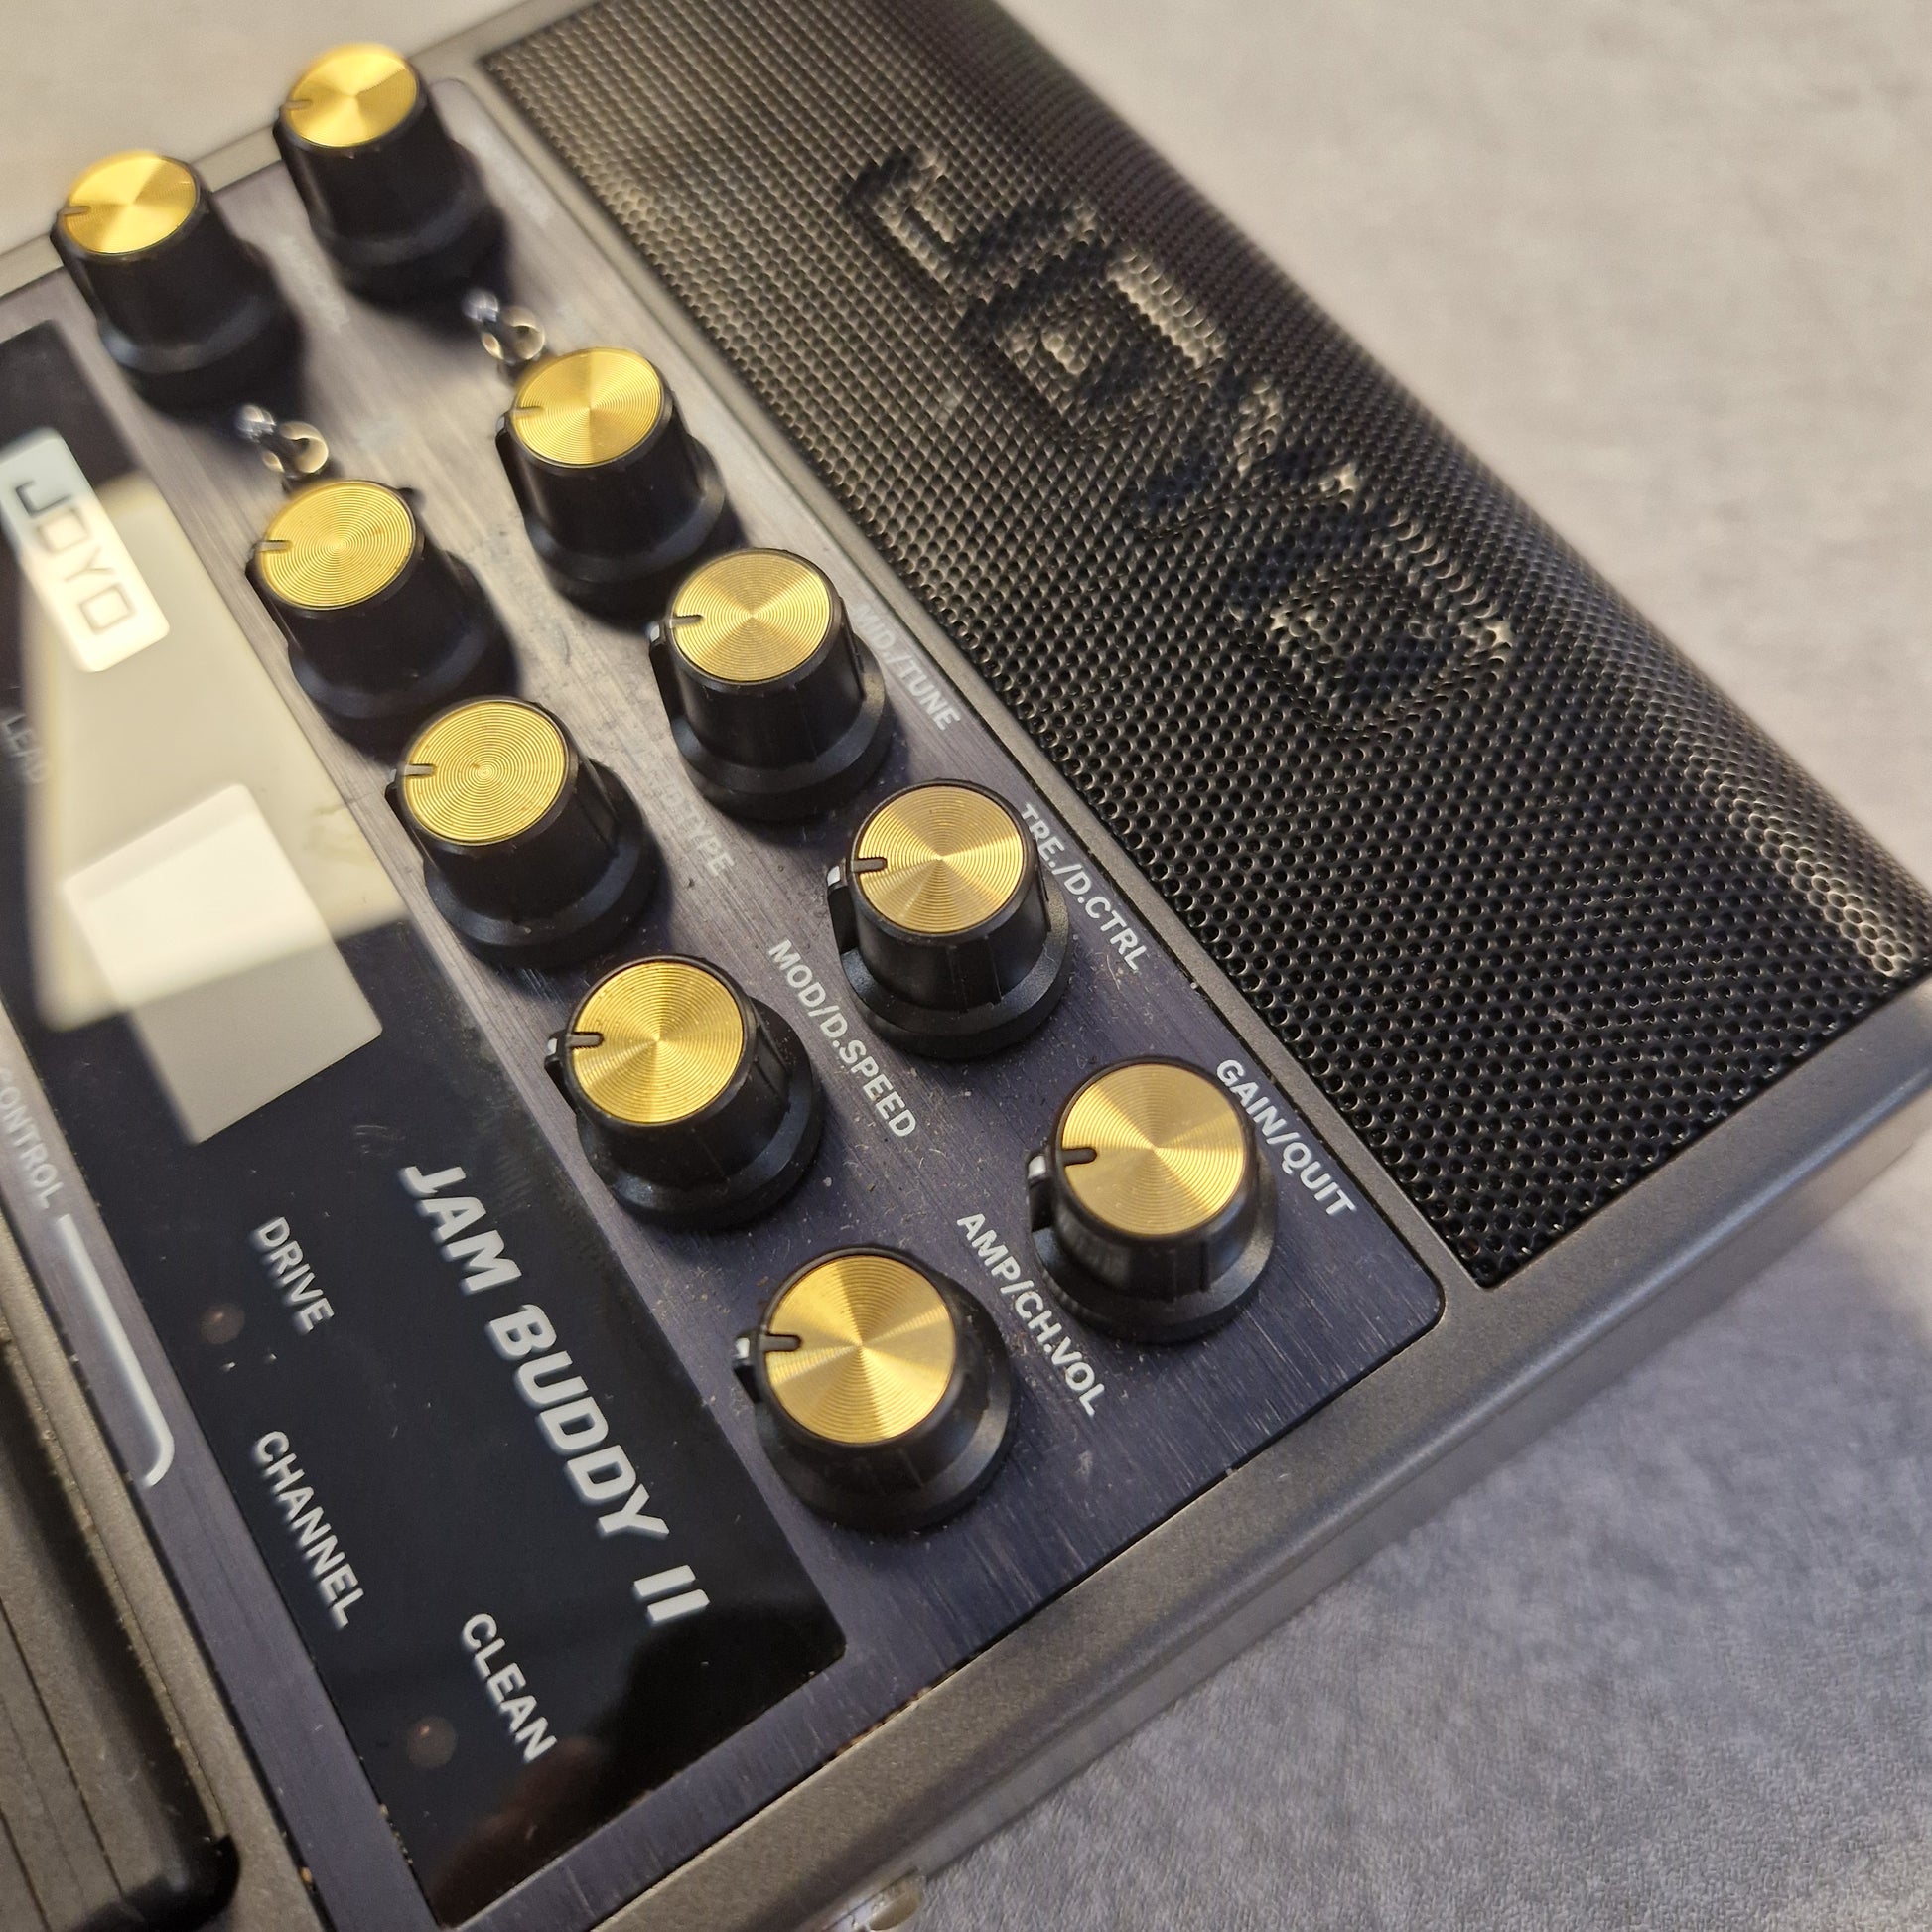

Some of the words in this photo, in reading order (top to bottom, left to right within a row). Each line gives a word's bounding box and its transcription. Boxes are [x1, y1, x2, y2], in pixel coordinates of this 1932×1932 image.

[15, 480, 136, 634] JOYO
[852, 603, 961, 730] MID./TUNE
[1019, 803, 1149, 971] TRE./D.CTRL
[768, 940, 917, 1138] MOD/D.SPEED
[1215, 1058, 1358, 1217] GAIN/QUIT
[253, 1216, 335, 1332] DRIVE
[956, 1212, 1109, 1417] AMP/CH.VOL
[400, 1166, 522, 1294] JAM
[485, 1304, 669, 1538] BUDDY
[633, 1564, 710, 1624] II
[254, 1430, 363, 1629] CHANNEL
[461, 1612, 558, 1762] CLEAN
